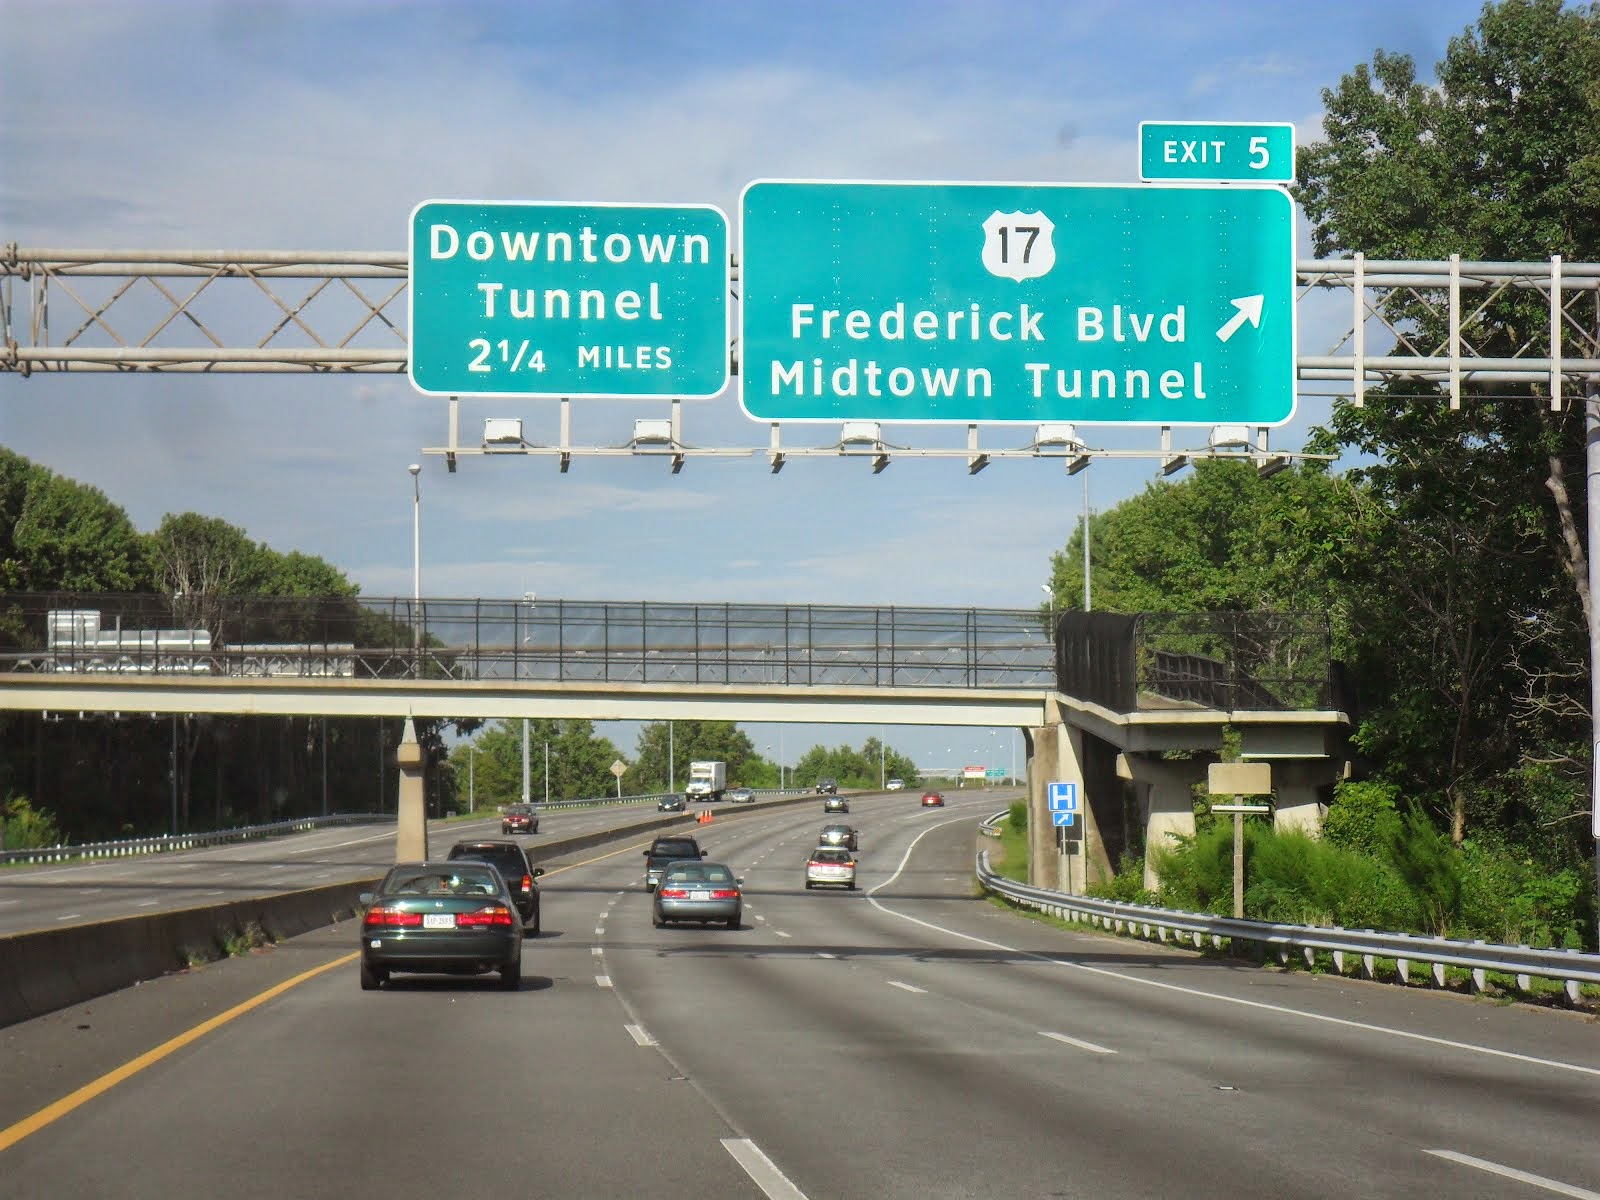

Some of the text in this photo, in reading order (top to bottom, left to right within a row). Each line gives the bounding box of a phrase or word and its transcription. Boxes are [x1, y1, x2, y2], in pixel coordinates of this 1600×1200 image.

[1164, 136, 1270, 170] EXIT 5
[430, 224, 709, 264] Downtown
[998, 226, 1040, 264] 17
[477, 282, 663, 320] Tunnel
[791, 303, 1186, 343] Frederick Blvd
[577, 345, 672, 370] MILES
[771, 357, 1206, 399] Midtown Tunnel
[1052, 785, 1073, 809] H
